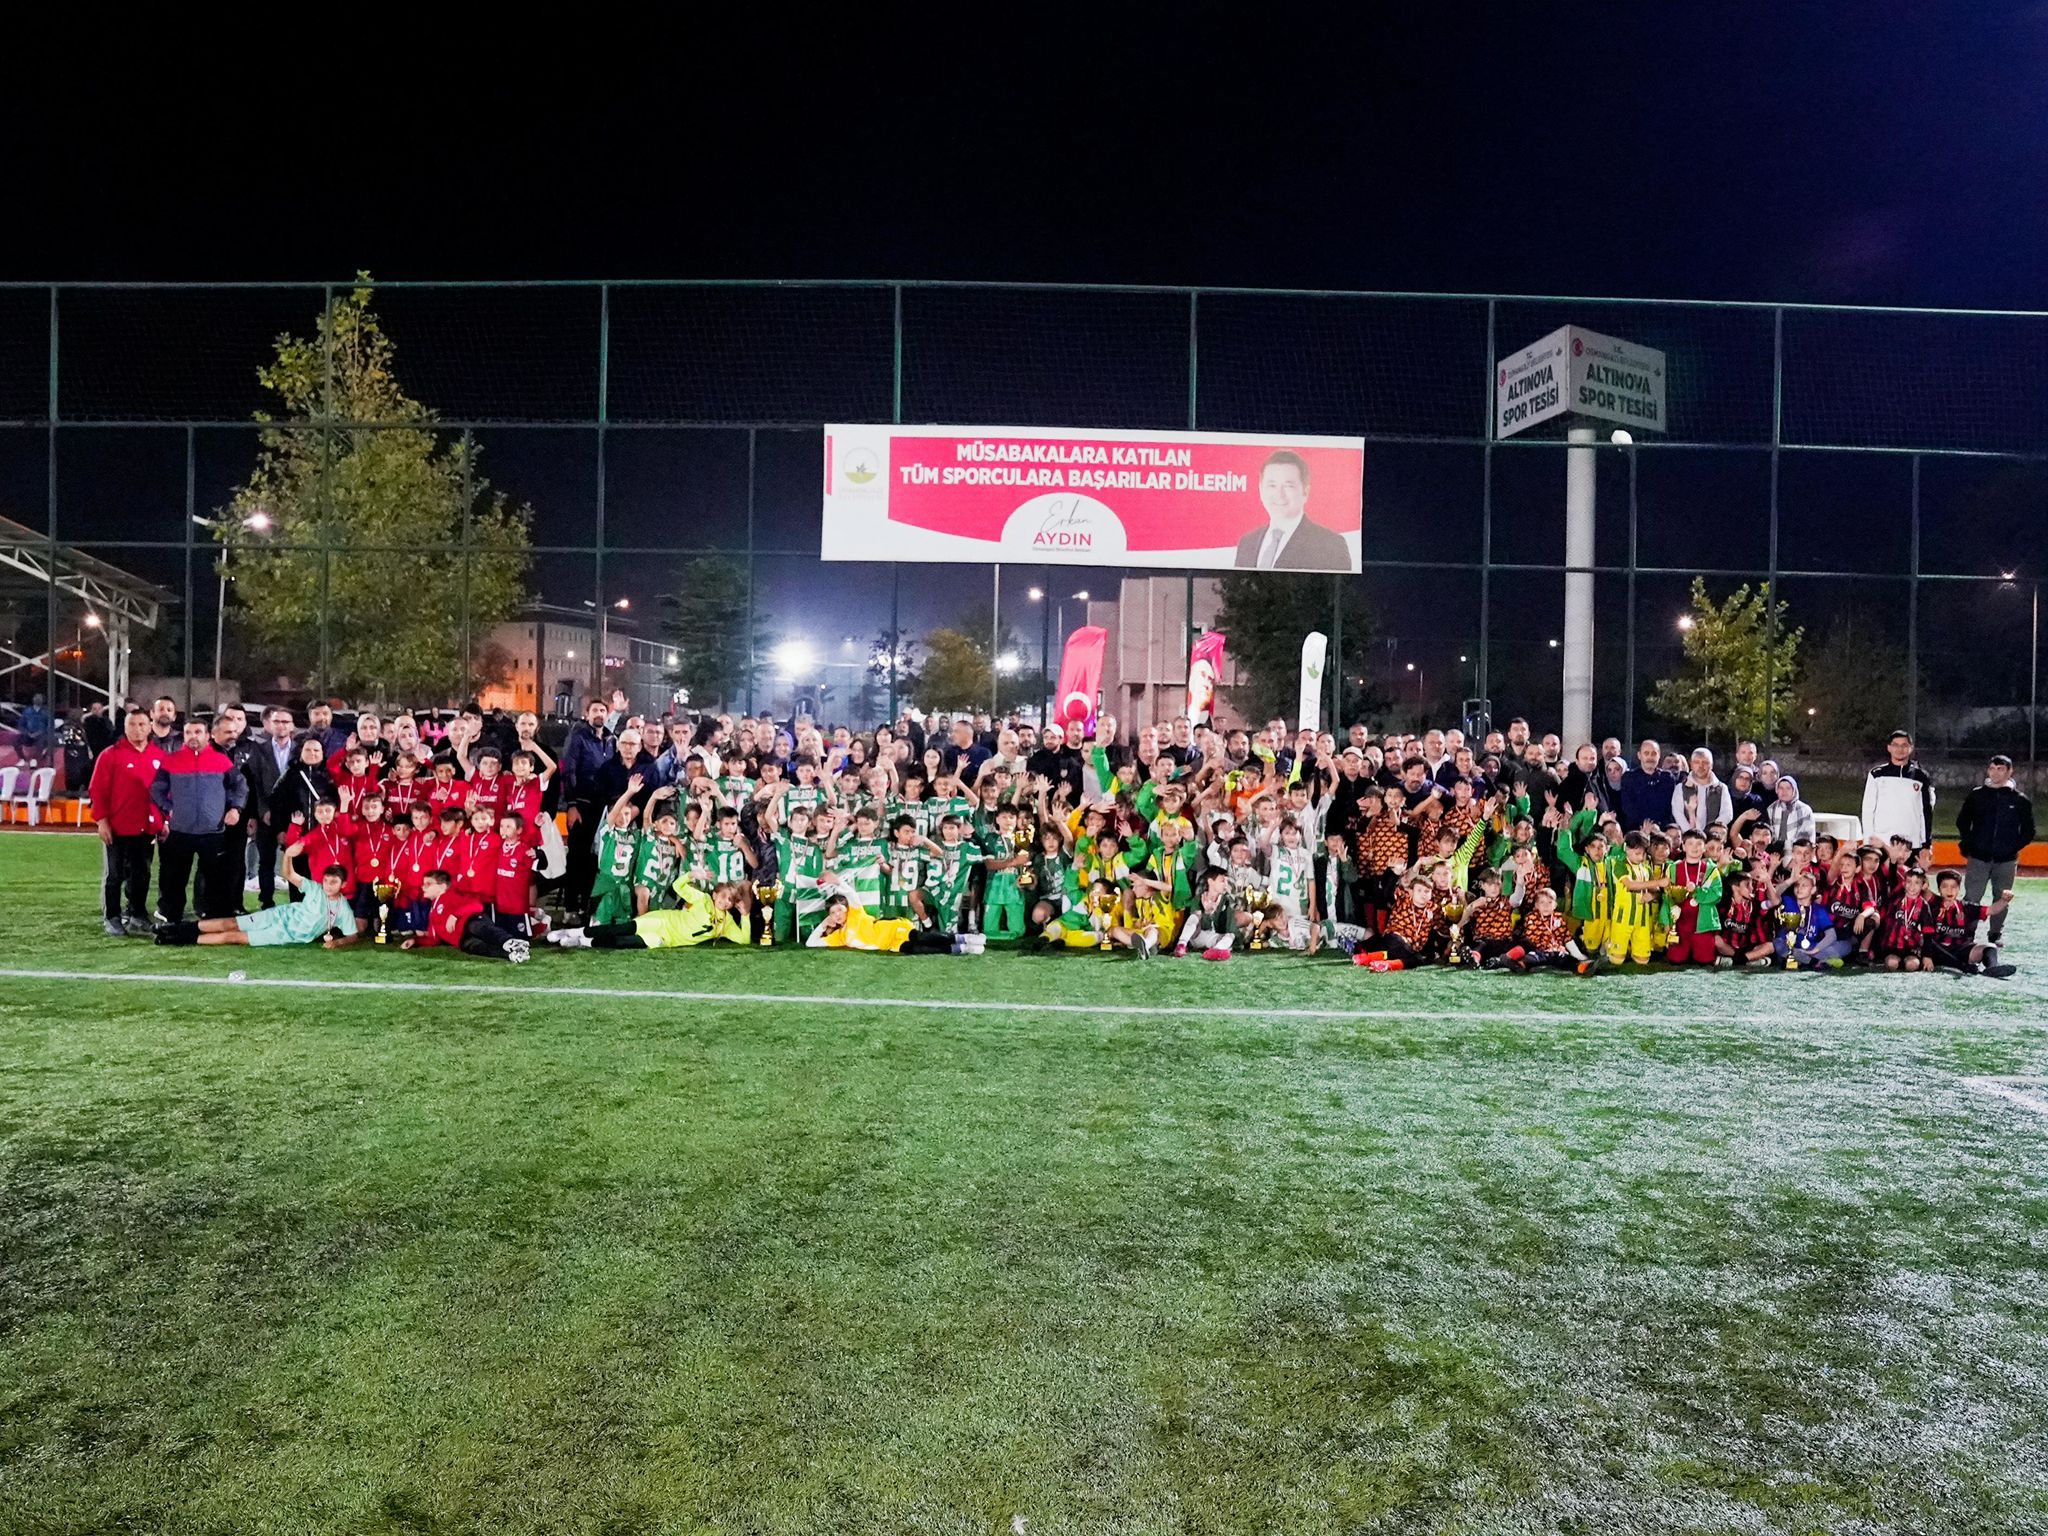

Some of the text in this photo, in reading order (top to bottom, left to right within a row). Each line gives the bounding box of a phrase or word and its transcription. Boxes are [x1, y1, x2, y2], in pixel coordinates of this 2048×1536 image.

[1507, 364, 1553, 402] ALTINOVA
[1587, 363, 1651, 395] ALTINOVA
[1503, 382, 1559, 427] SPOR TESİSİ
[1579, 385, 1657, 421] SPOR TESİSİ
[957, 440, 1191, 467] MÜSABAKALARA KATILAN
[900, 463, 1247, 492] TÜM SPORCULARA BAŞARILAR DİLERİM
[1041, 500, 1091, 532] Erkan
[1033, 532, 1091, 546] AYDIN
[718, 851, 745, 882] 18
[891, 858, 918, 890] 19
[1277, 864, 1306, 898] 24
